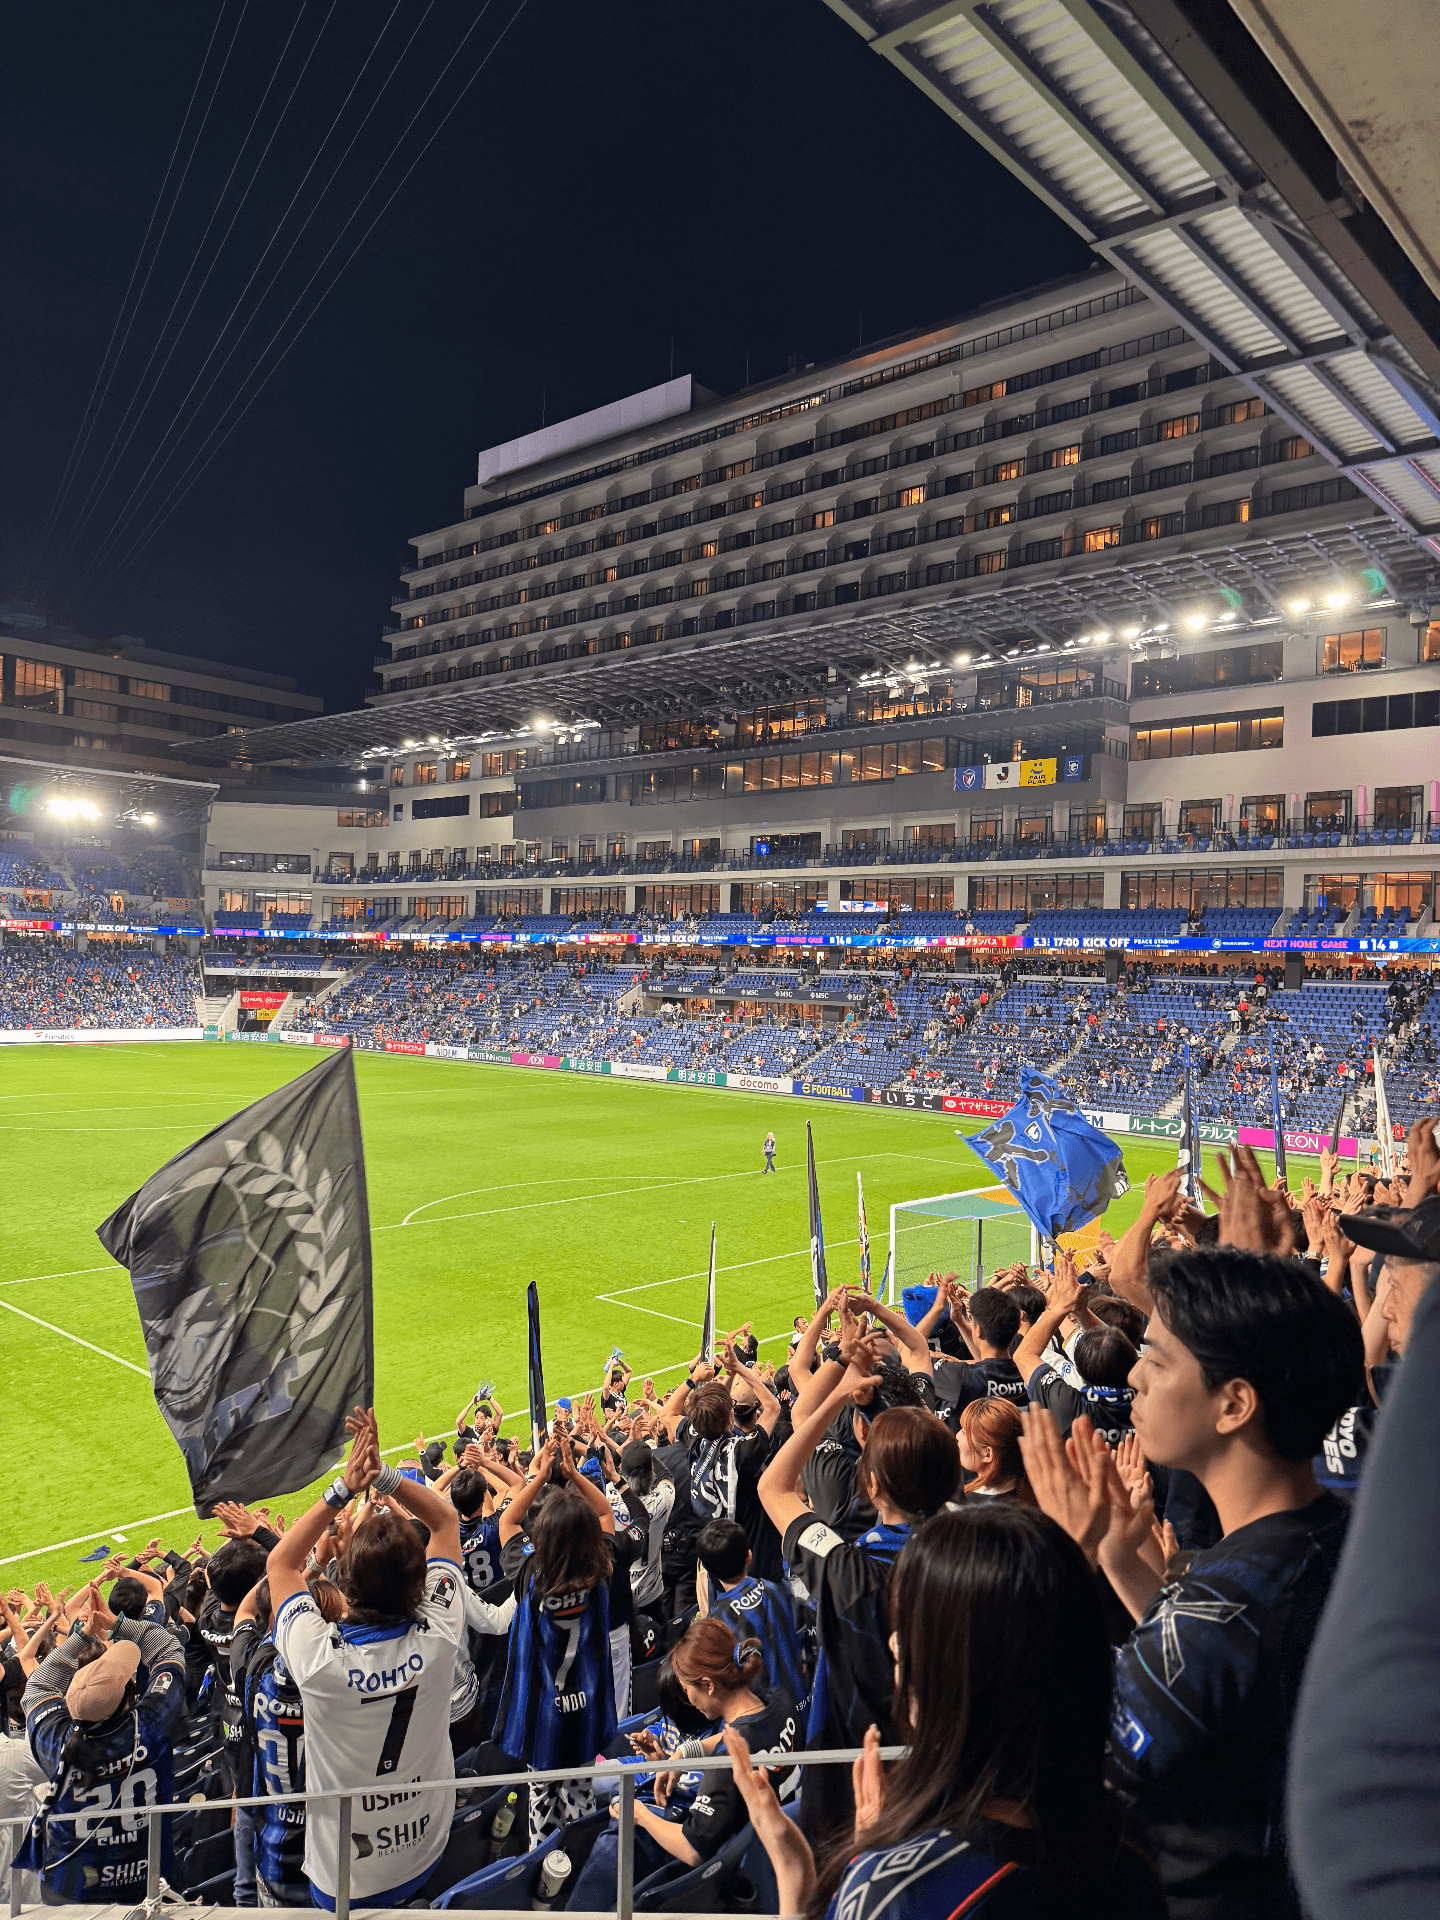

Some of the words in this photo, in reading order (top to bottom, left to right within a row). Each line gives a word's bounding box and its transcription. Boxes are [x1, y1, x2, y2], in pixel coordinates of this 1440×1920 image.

[686, 935, 700, 943] OFF
[1053, 938, 1080, 946] 17:00
[1082, 938, 1108, 947] KICK
[1109, 938, 1130, 947] OFF
[1264, 939, 1288, 948] NEXT
[1290, 940, 1318, 948] HOME
[1321, 940, 1348, 949] GAME
[232, 1033, 268, 1041] 明治安田
[287, 1034, 308, 1042] docomo
[320, 1036, 342, 1044] KONAMI
[359, 1039, 383, 1050] いちご
[436, 1048, 457, 1058] AIDEM
[469, 1052, 486, 1060] ROUTE
[486, 1050, 495, 1061] INN
[569, 1060, 602, 1072] 明治安田
[678, 1070, 716, 1084] 明治安田
[740, 1077, 778, 1090] docomo
[886, 1092, 934, 1108] いちご
[811, 1528, 827, 1548] AFC
[730, 1581, 765, 1616] ROHTO
[552, 1618, 580, 1692] 7
[347, 1654, 424, 1693] ROHTO
[360, 1684, 419, 1777] 7
[74, 1767, 158, 1840] 20
[376, 1814, 430, 1850] SHIP
[101, 1860, 148, 1882] SHIP
